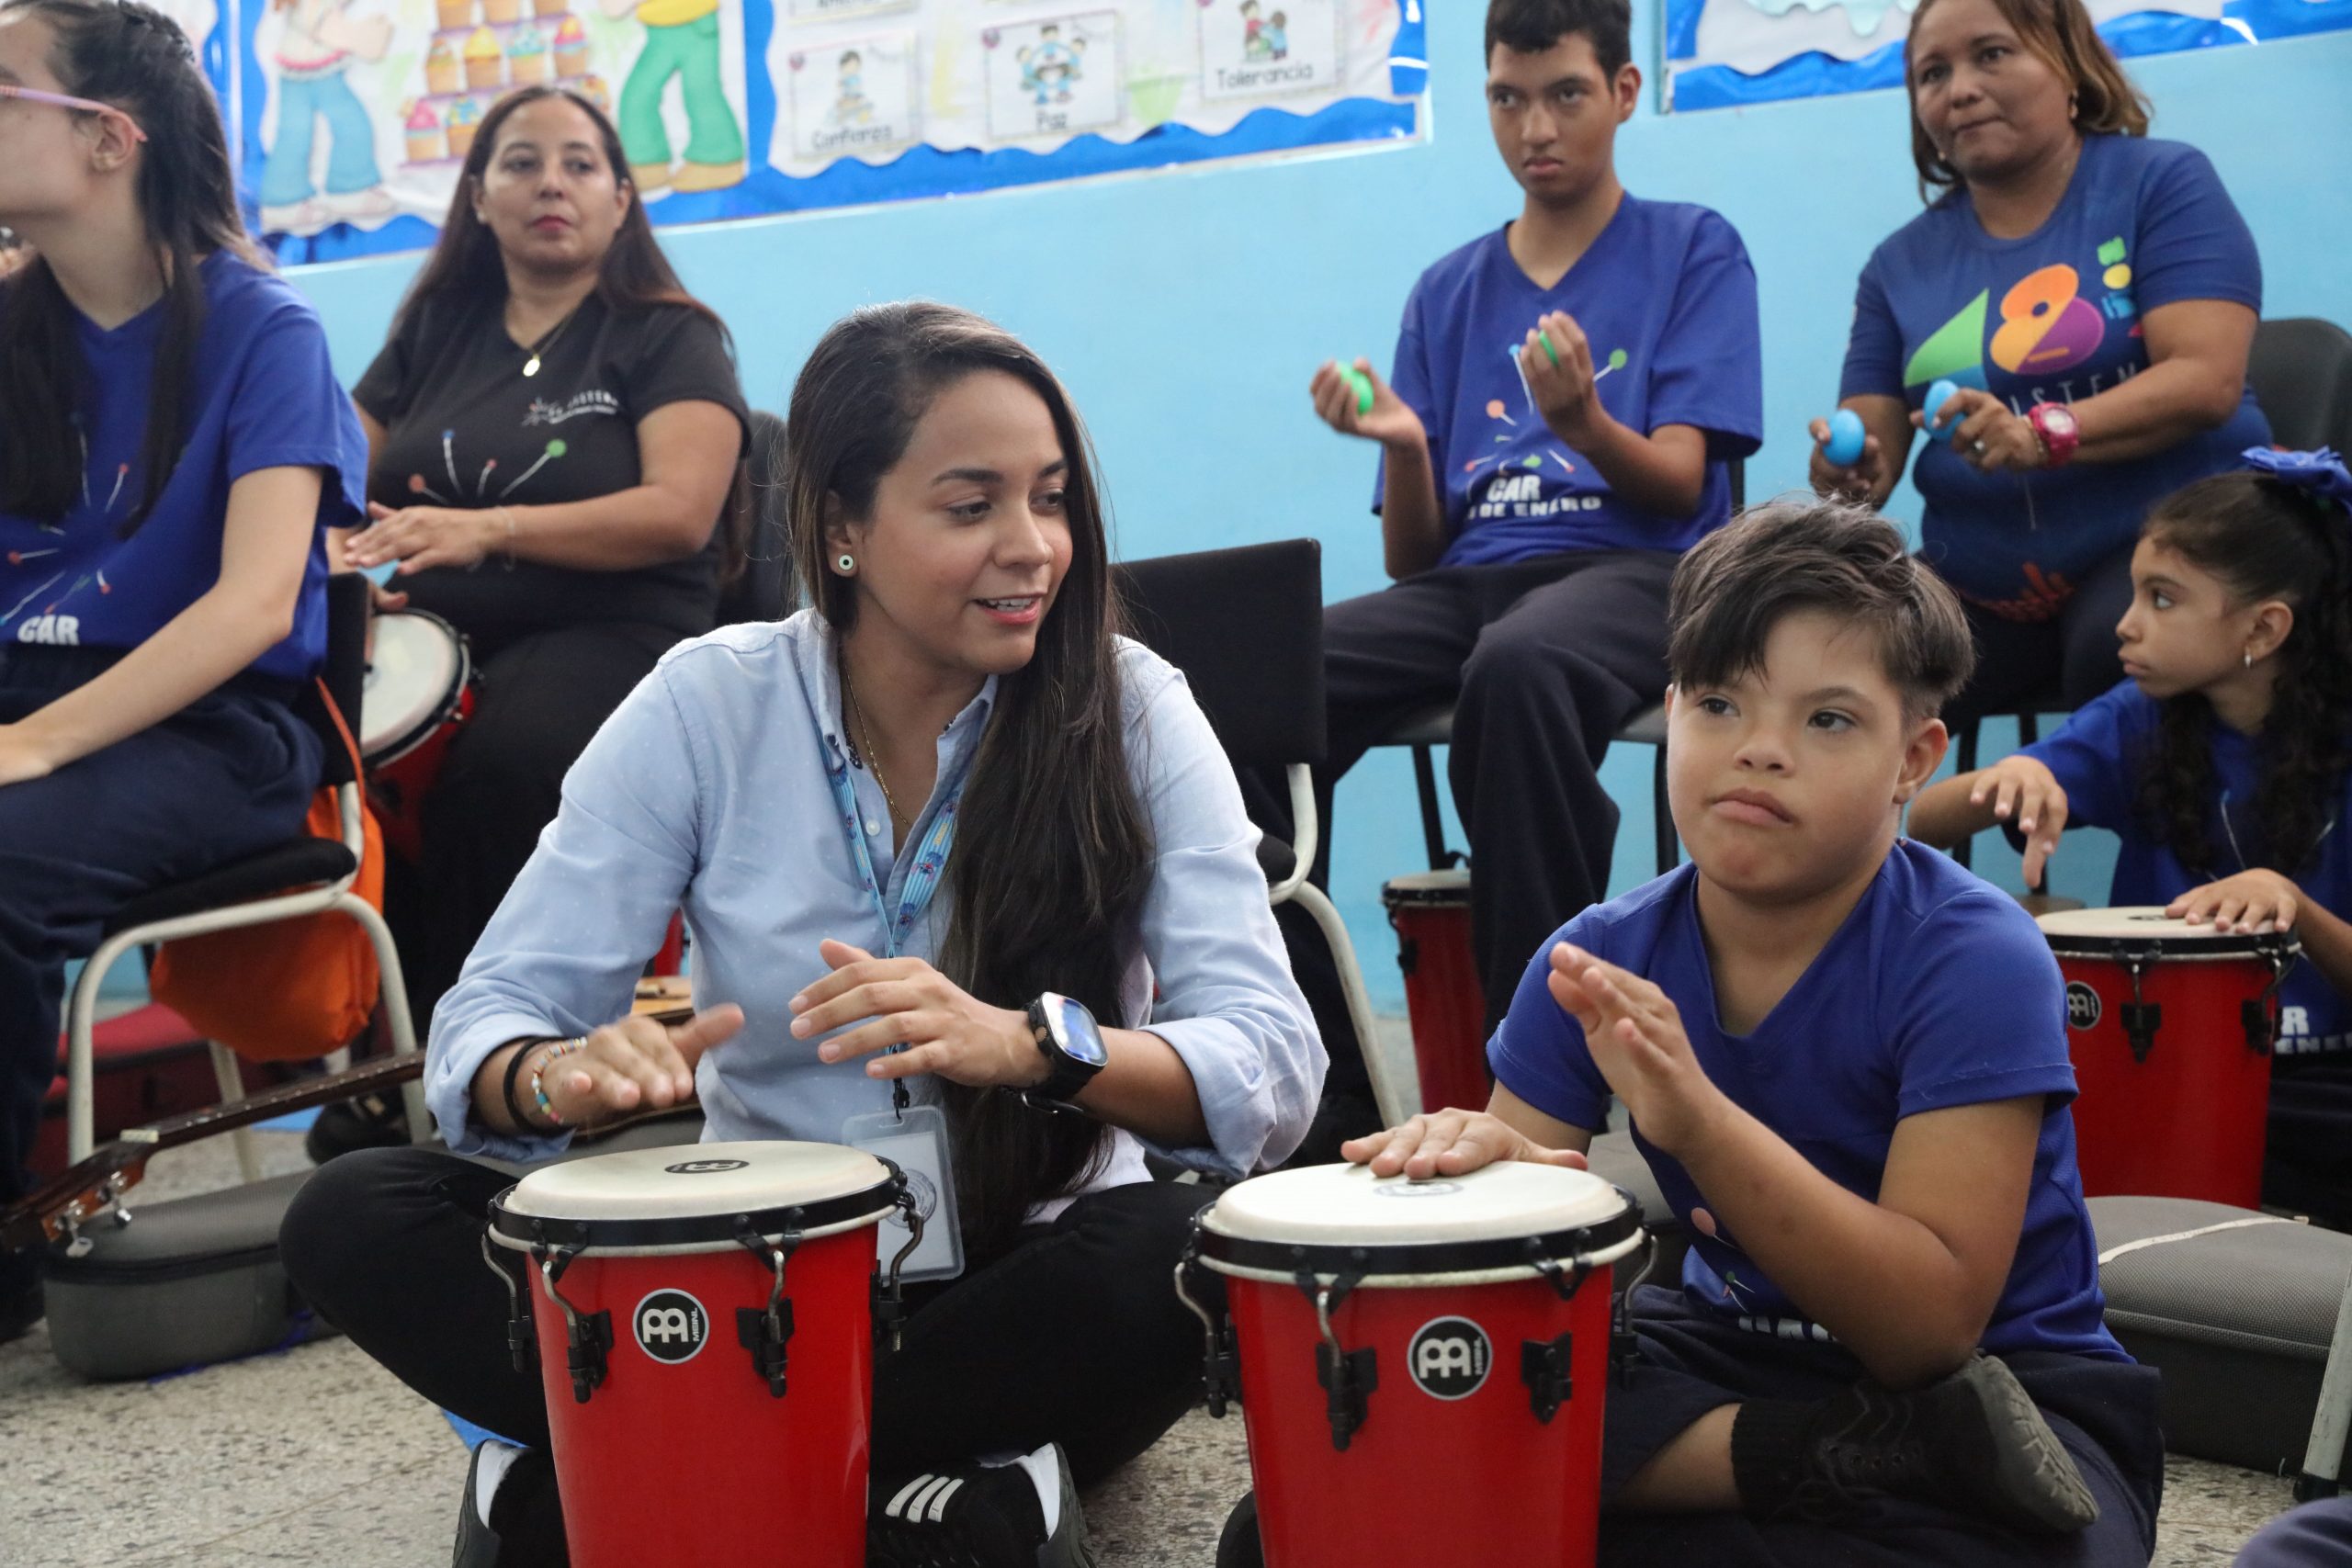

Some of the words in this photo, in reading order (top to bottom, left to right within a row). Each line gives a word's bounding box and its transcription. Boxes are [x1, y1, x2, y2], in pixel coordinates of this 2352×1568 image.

[1215, 62, 1313, 90] Tolerancia
[1487, 474, 1542, 502] CAR
[691, 1307, 700, 1342] MEINL
